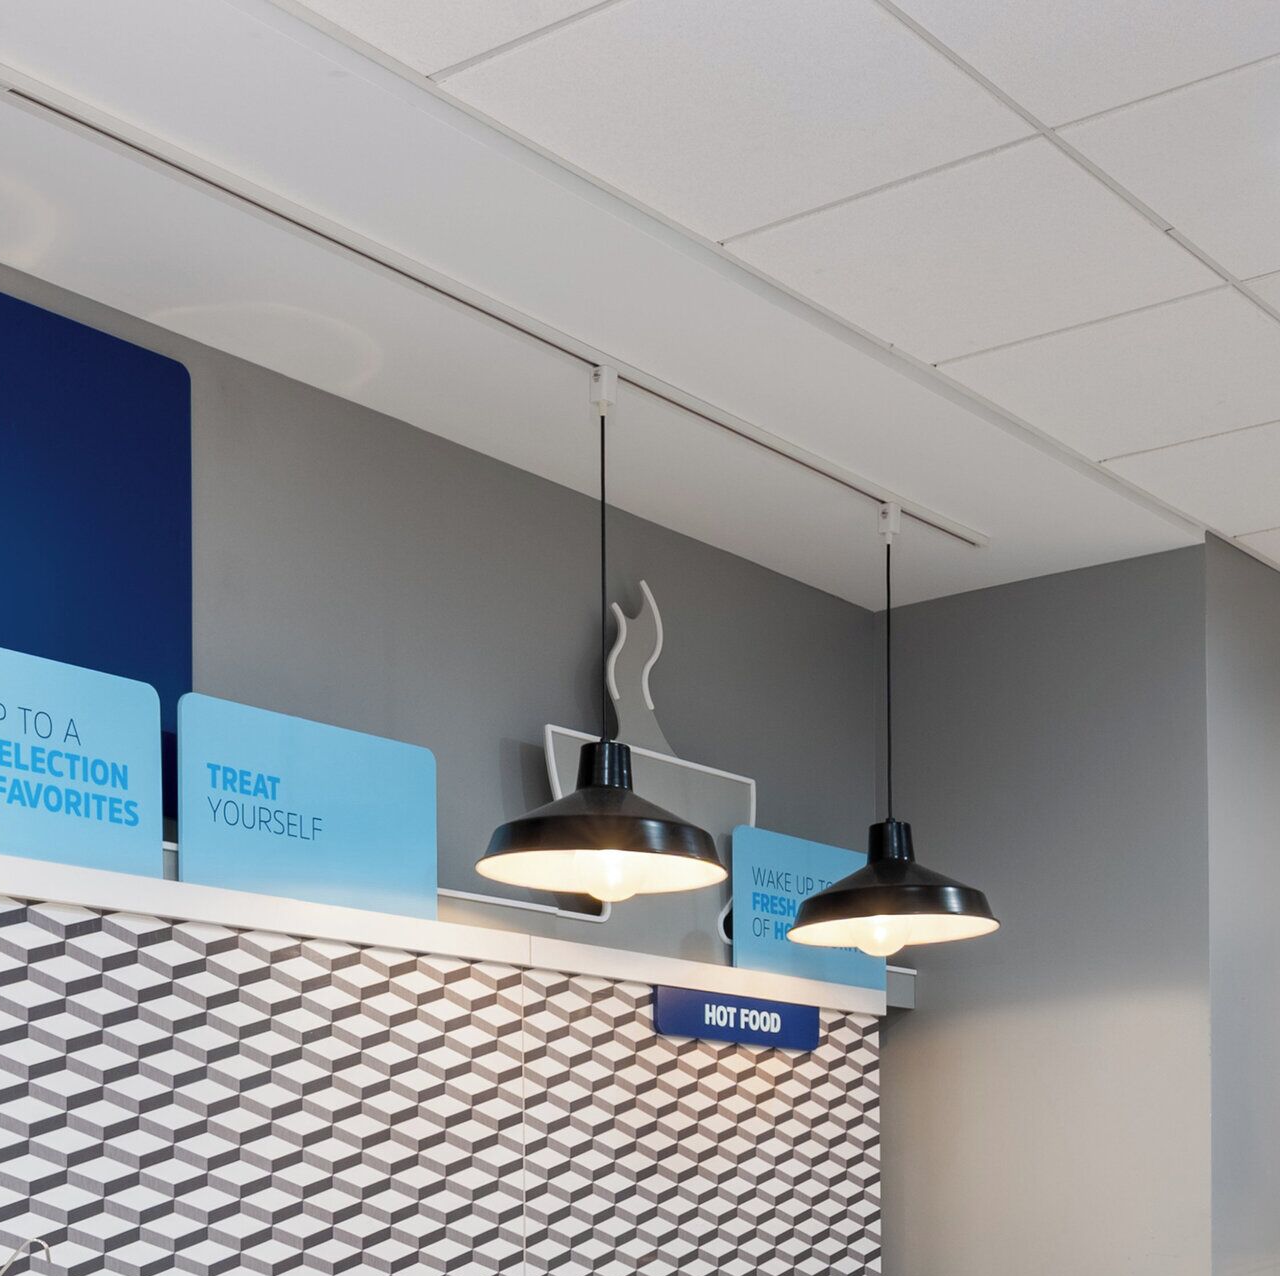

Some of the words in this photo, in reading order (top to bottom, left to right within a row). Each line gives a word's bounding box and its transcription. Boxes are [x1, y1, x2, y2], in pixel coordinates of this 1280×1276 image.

[17, 706, 53, 739] TO
[63, 718, 81, 746] A
[207, 762, 280, 801] TREAT
[207, 795, 323, 843] YOURSELF
[751, 866, 792, 892] WAKE
[796, 874, 814, 896] UP
[752, 892, 796, 918] FRESH
[752, 917, 770, 938] OF
[704, 1003, 736, 1028] HOT
[740, 1006, 781, 1034] FOOD
